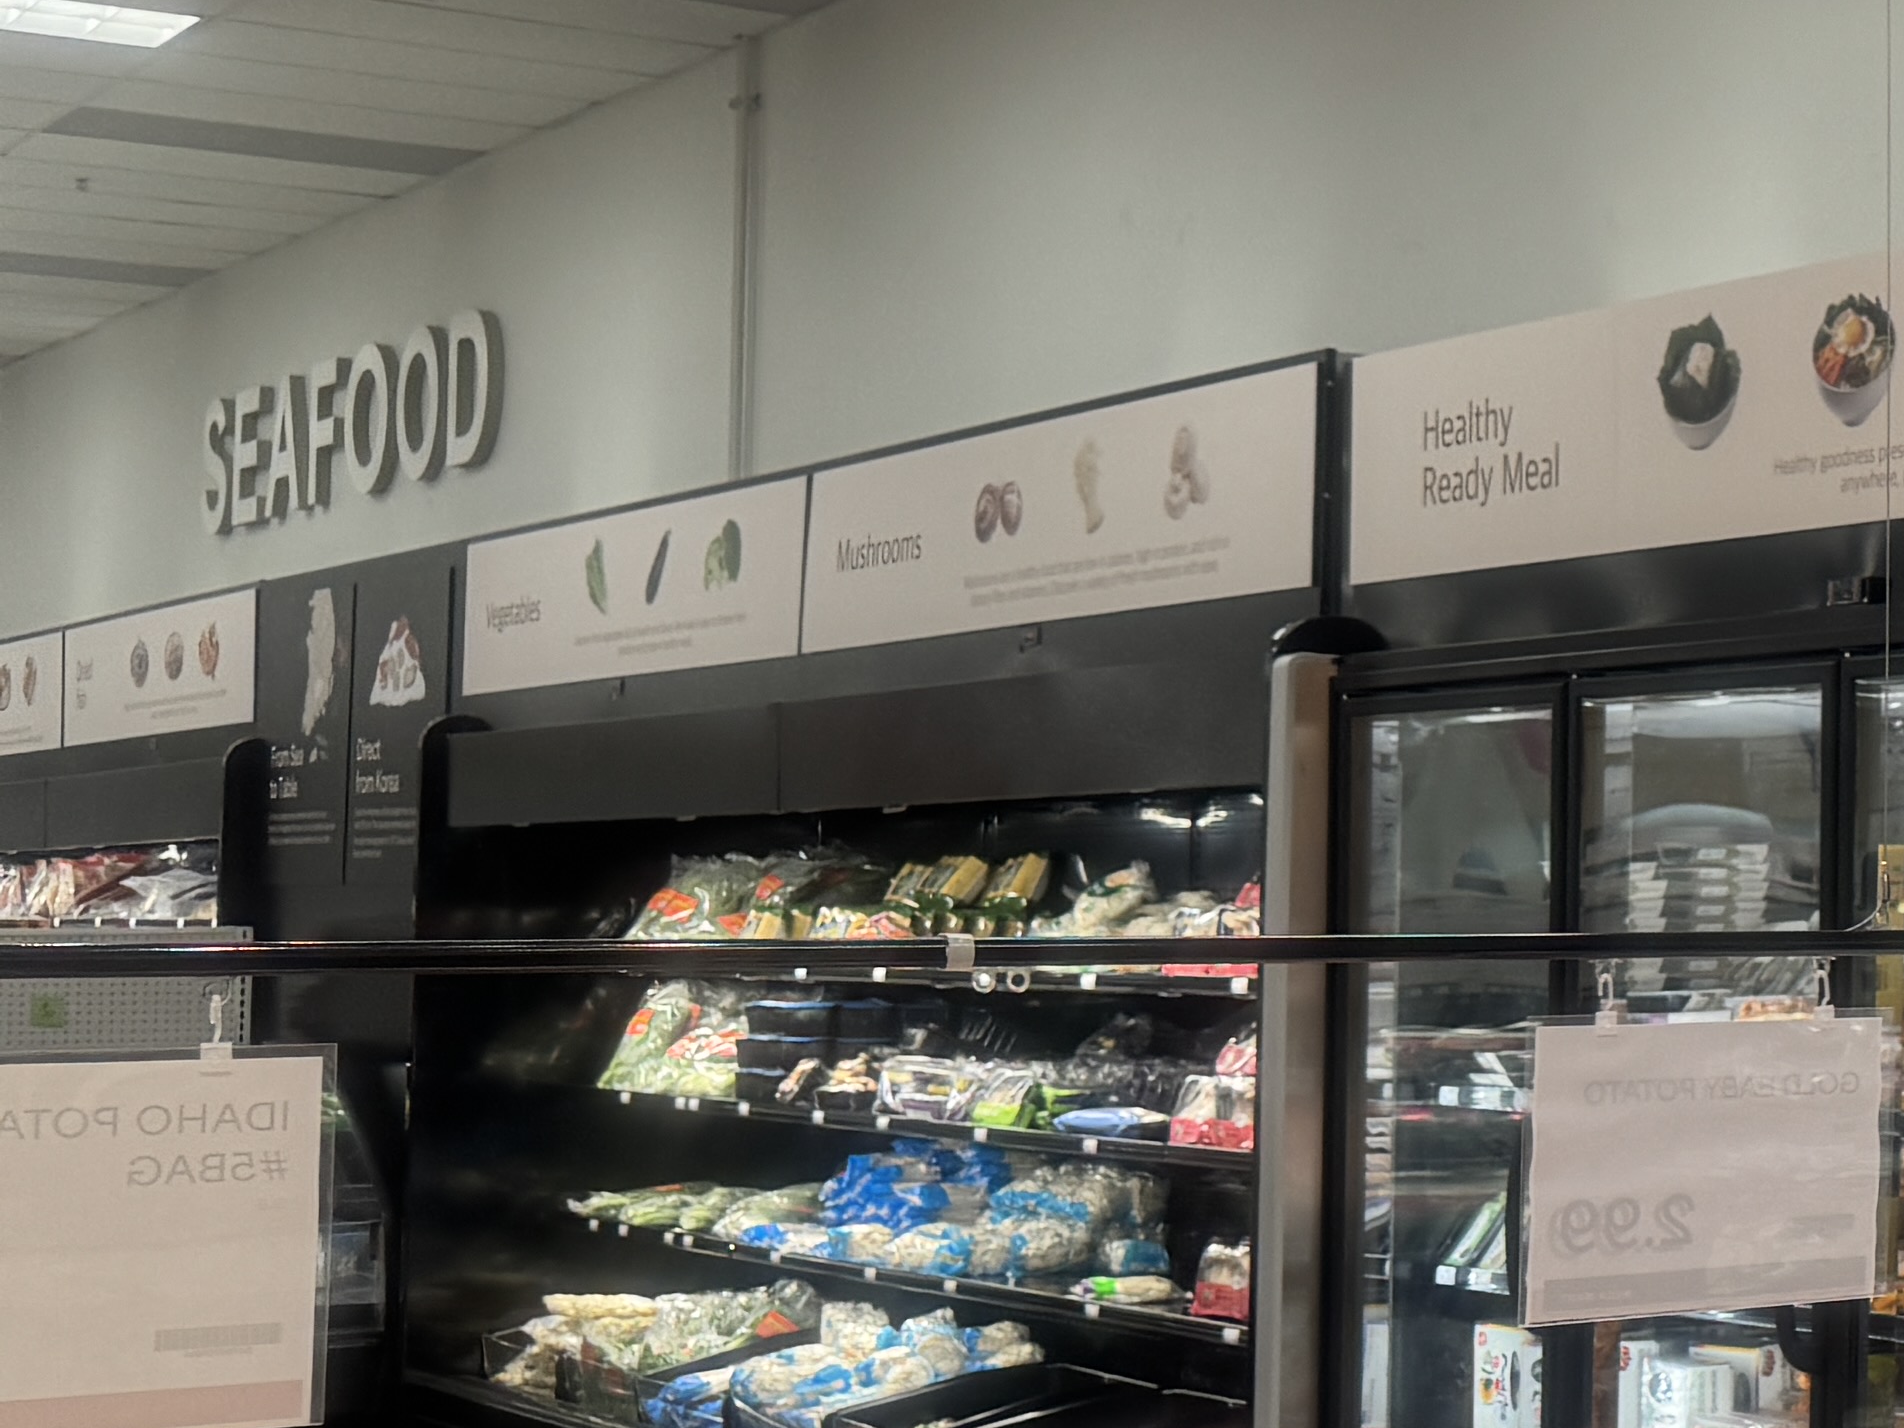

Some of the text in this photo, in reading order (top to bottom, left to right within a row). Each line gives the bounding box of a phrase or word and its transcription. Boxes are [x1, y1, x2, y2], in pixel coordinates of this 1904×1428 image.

[202, 308, 505, 536] SEAFOOD
[1422, 399, 1513, 454] Healthy
[1422, 441, 1561, 507] Ready Meal
[836, 532, 923, 572] Mushrooms
